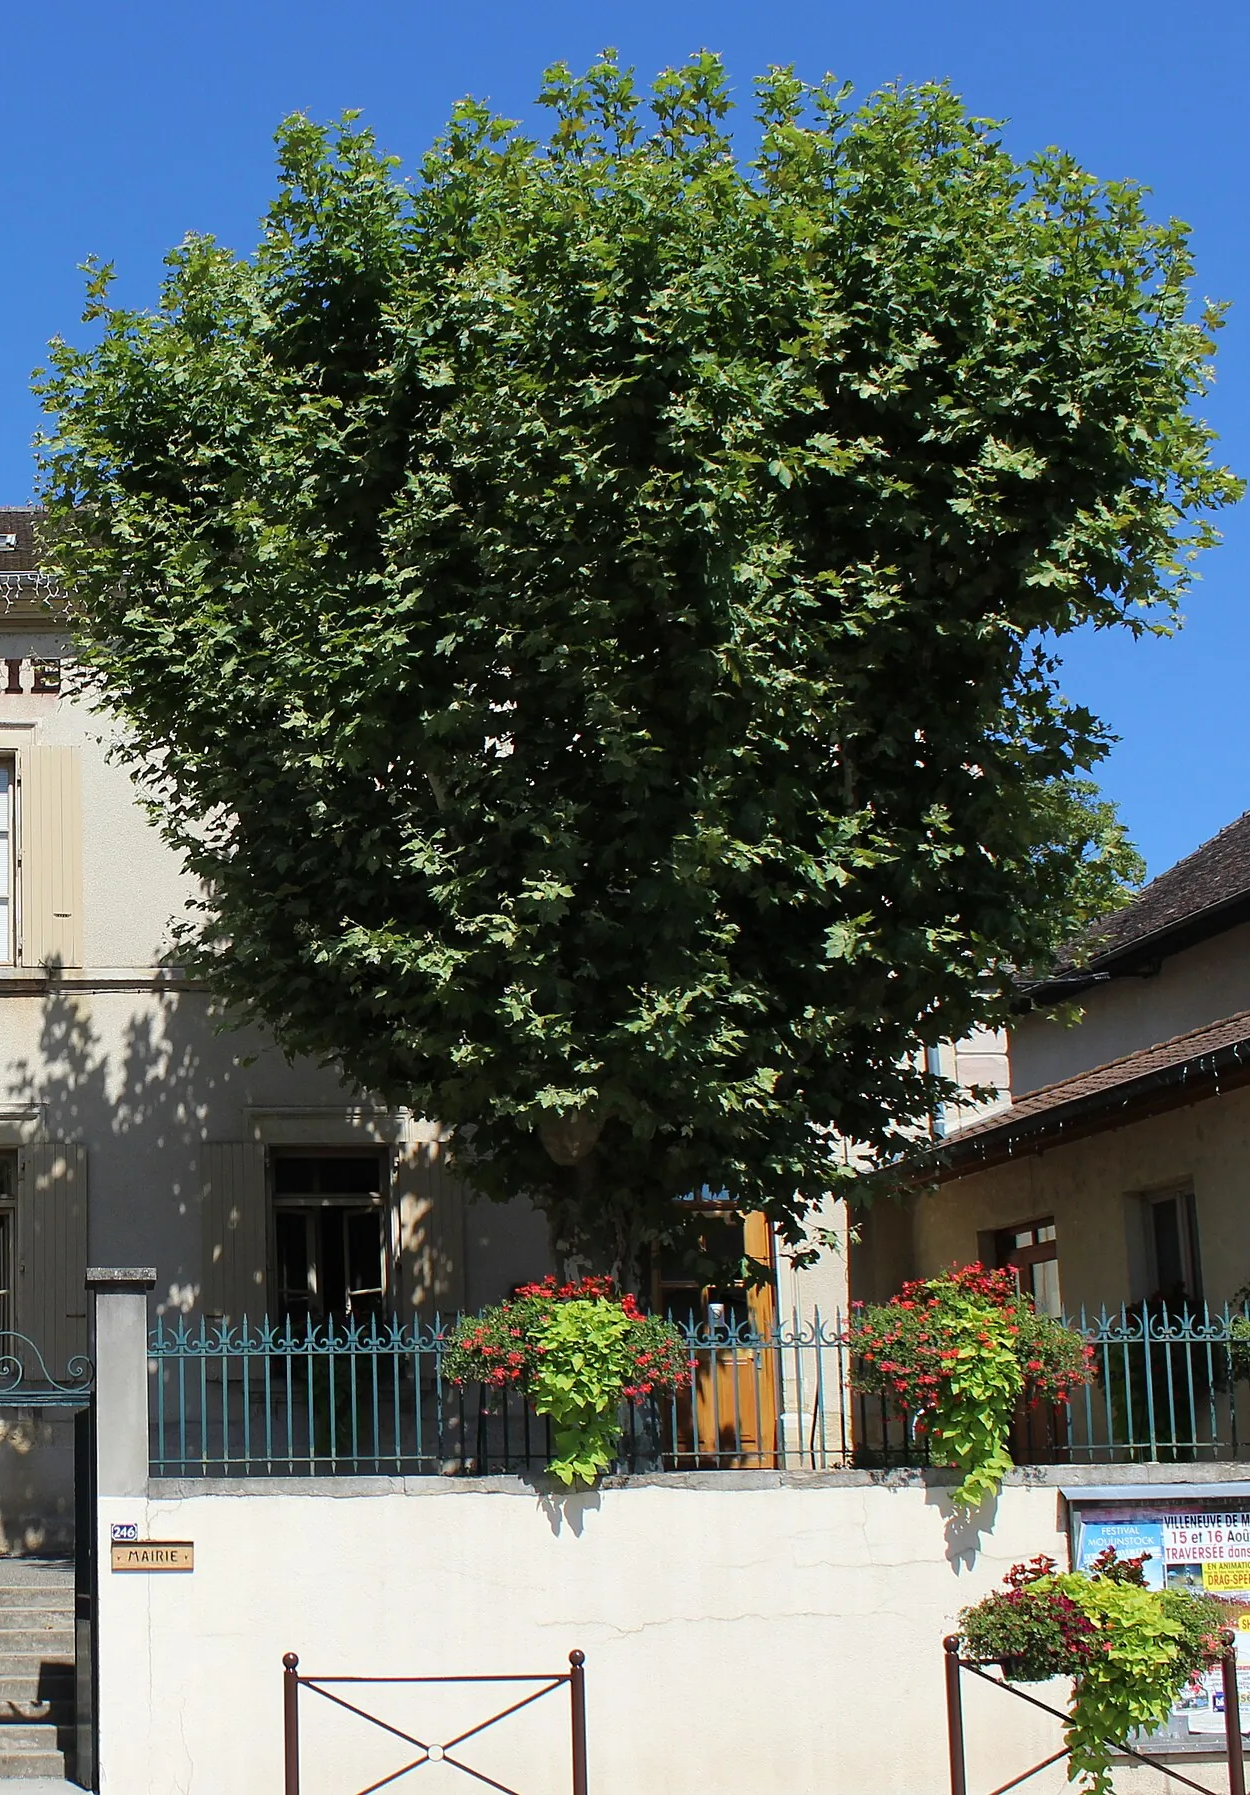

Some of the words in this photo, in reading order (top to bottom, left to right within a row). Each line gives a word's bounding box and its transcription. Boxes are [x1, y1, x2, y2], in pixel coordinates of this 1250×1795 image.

[1164, 1514, 1222, 1529] VILLENEUVE
[1225, 1514, 1238, 1528] DE
[114, 1526, 135, 1538] 246
[1101, 1526, 1140, 1536] FESTIVAL
[1171, 1531, 1187, 1544] 15
[1191, 1531, 1202, 1544] et
[1207, 1530, 1223, 1544] 16
[128, 1550, 178, 1562] MAIRIE
[1166, 1544, 1224, 1559] TRAVERSÉE
[1207, 1562, 1217, 1570] EN
